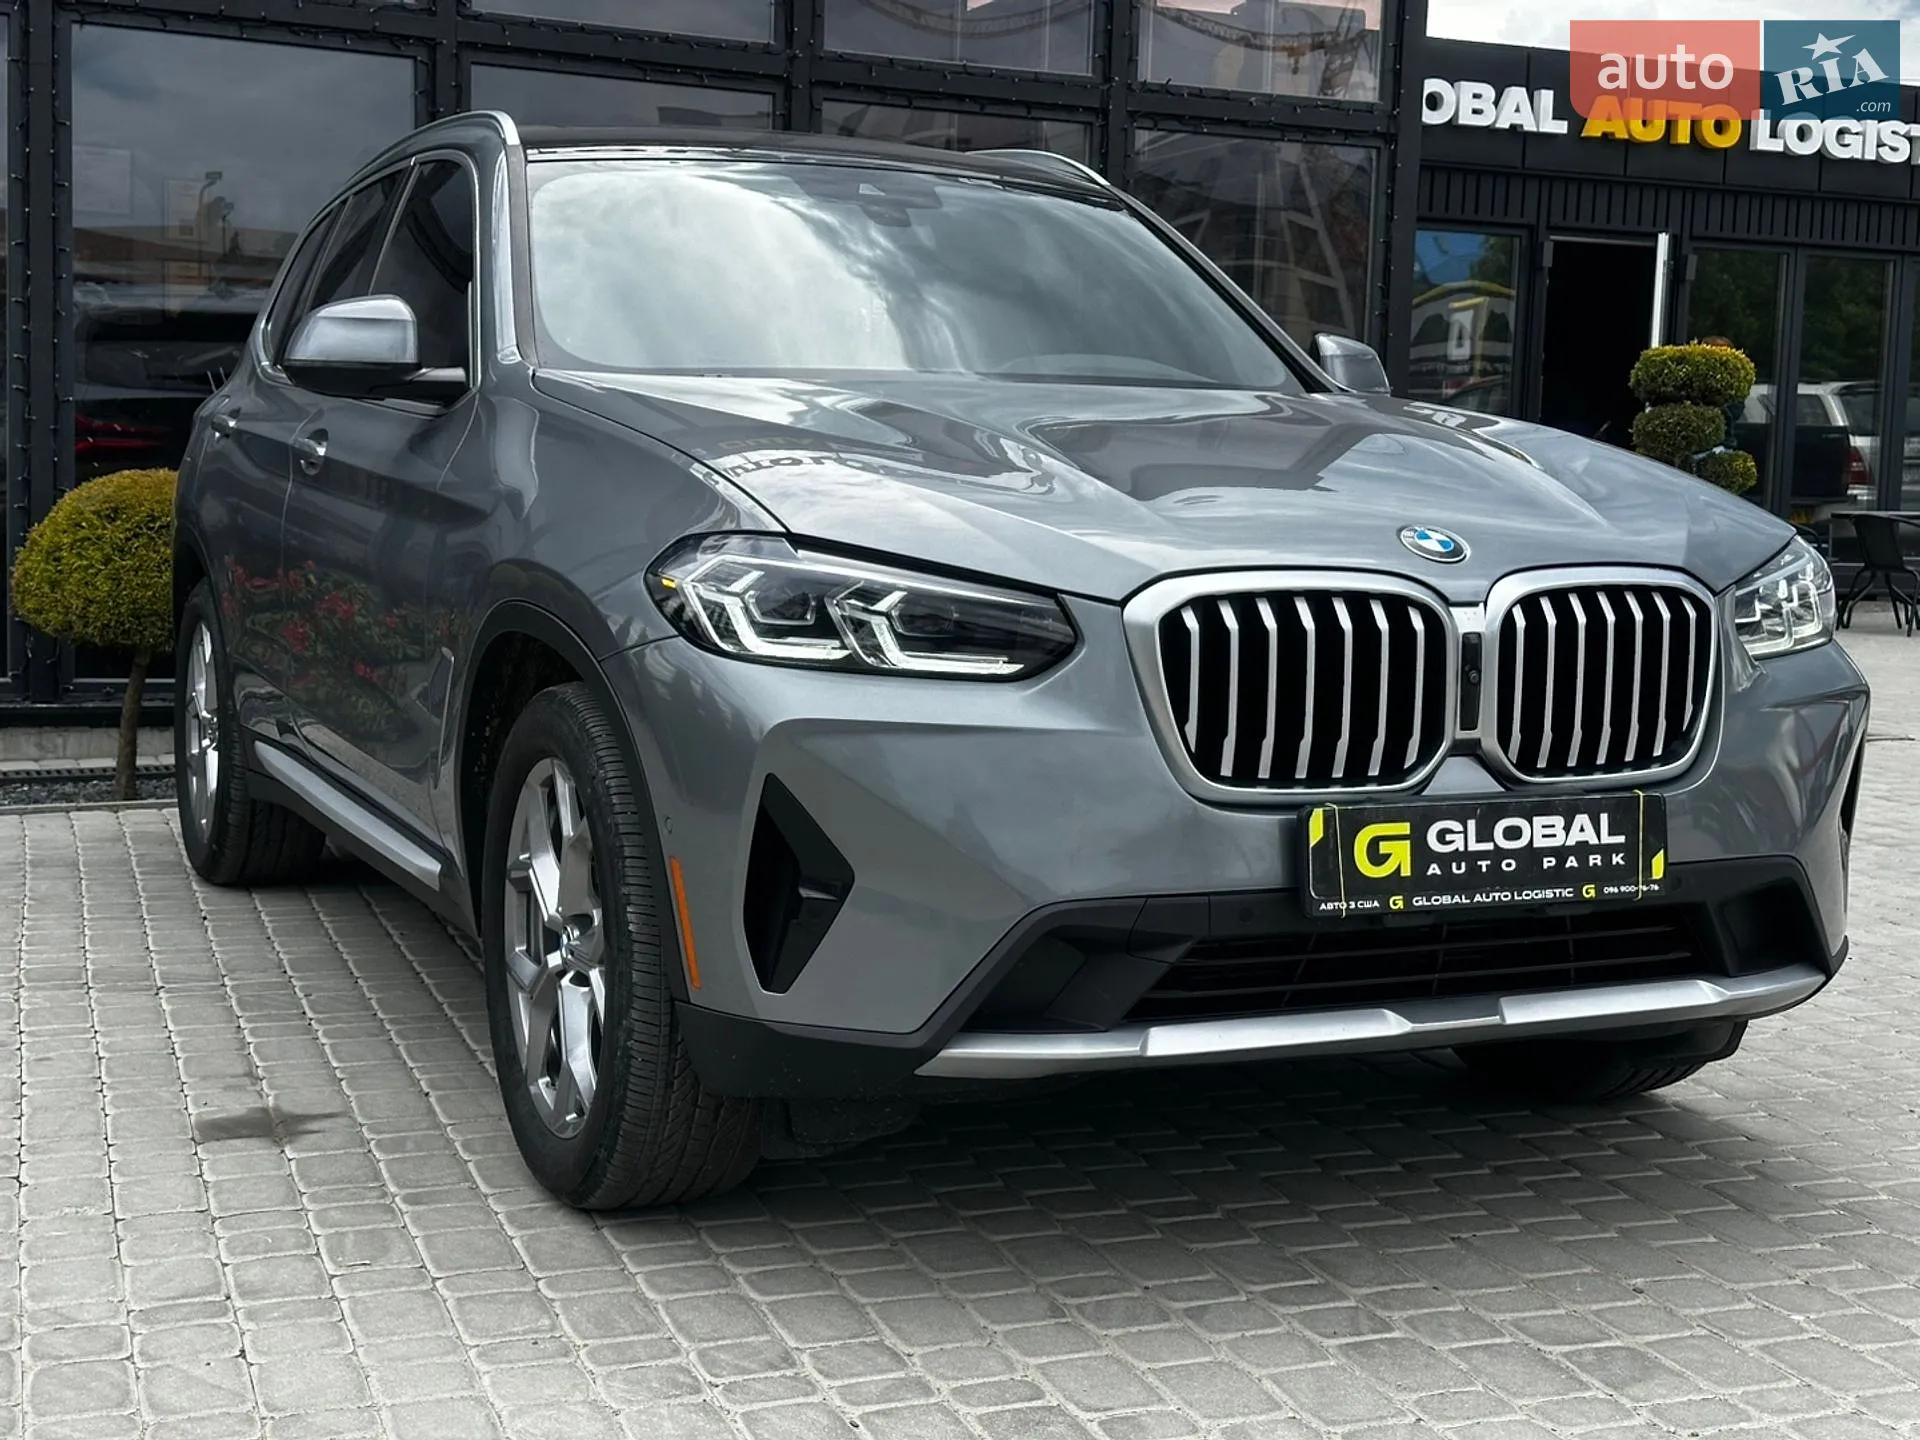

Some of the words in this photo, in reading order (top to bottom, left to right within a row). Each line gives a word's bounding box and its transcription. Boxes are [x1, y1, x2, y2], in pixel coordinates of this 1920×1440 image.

[1421, 78, 1568, 134] OBAL
[1581, 95, 1741, 149] AUTO
[1426, 813, 1626, 853] GLOBAL
[1426, 859, 1517, 875] AUTO
[1542, 853, 1625, 869] PARK
[1357, 900, 1380, 908] США
[1412, 894, 1470, 906] GLOBAL
[1473, 891, 1512, 902] AUTO
[1514, 888, 1574, 900] LOGISTIC
